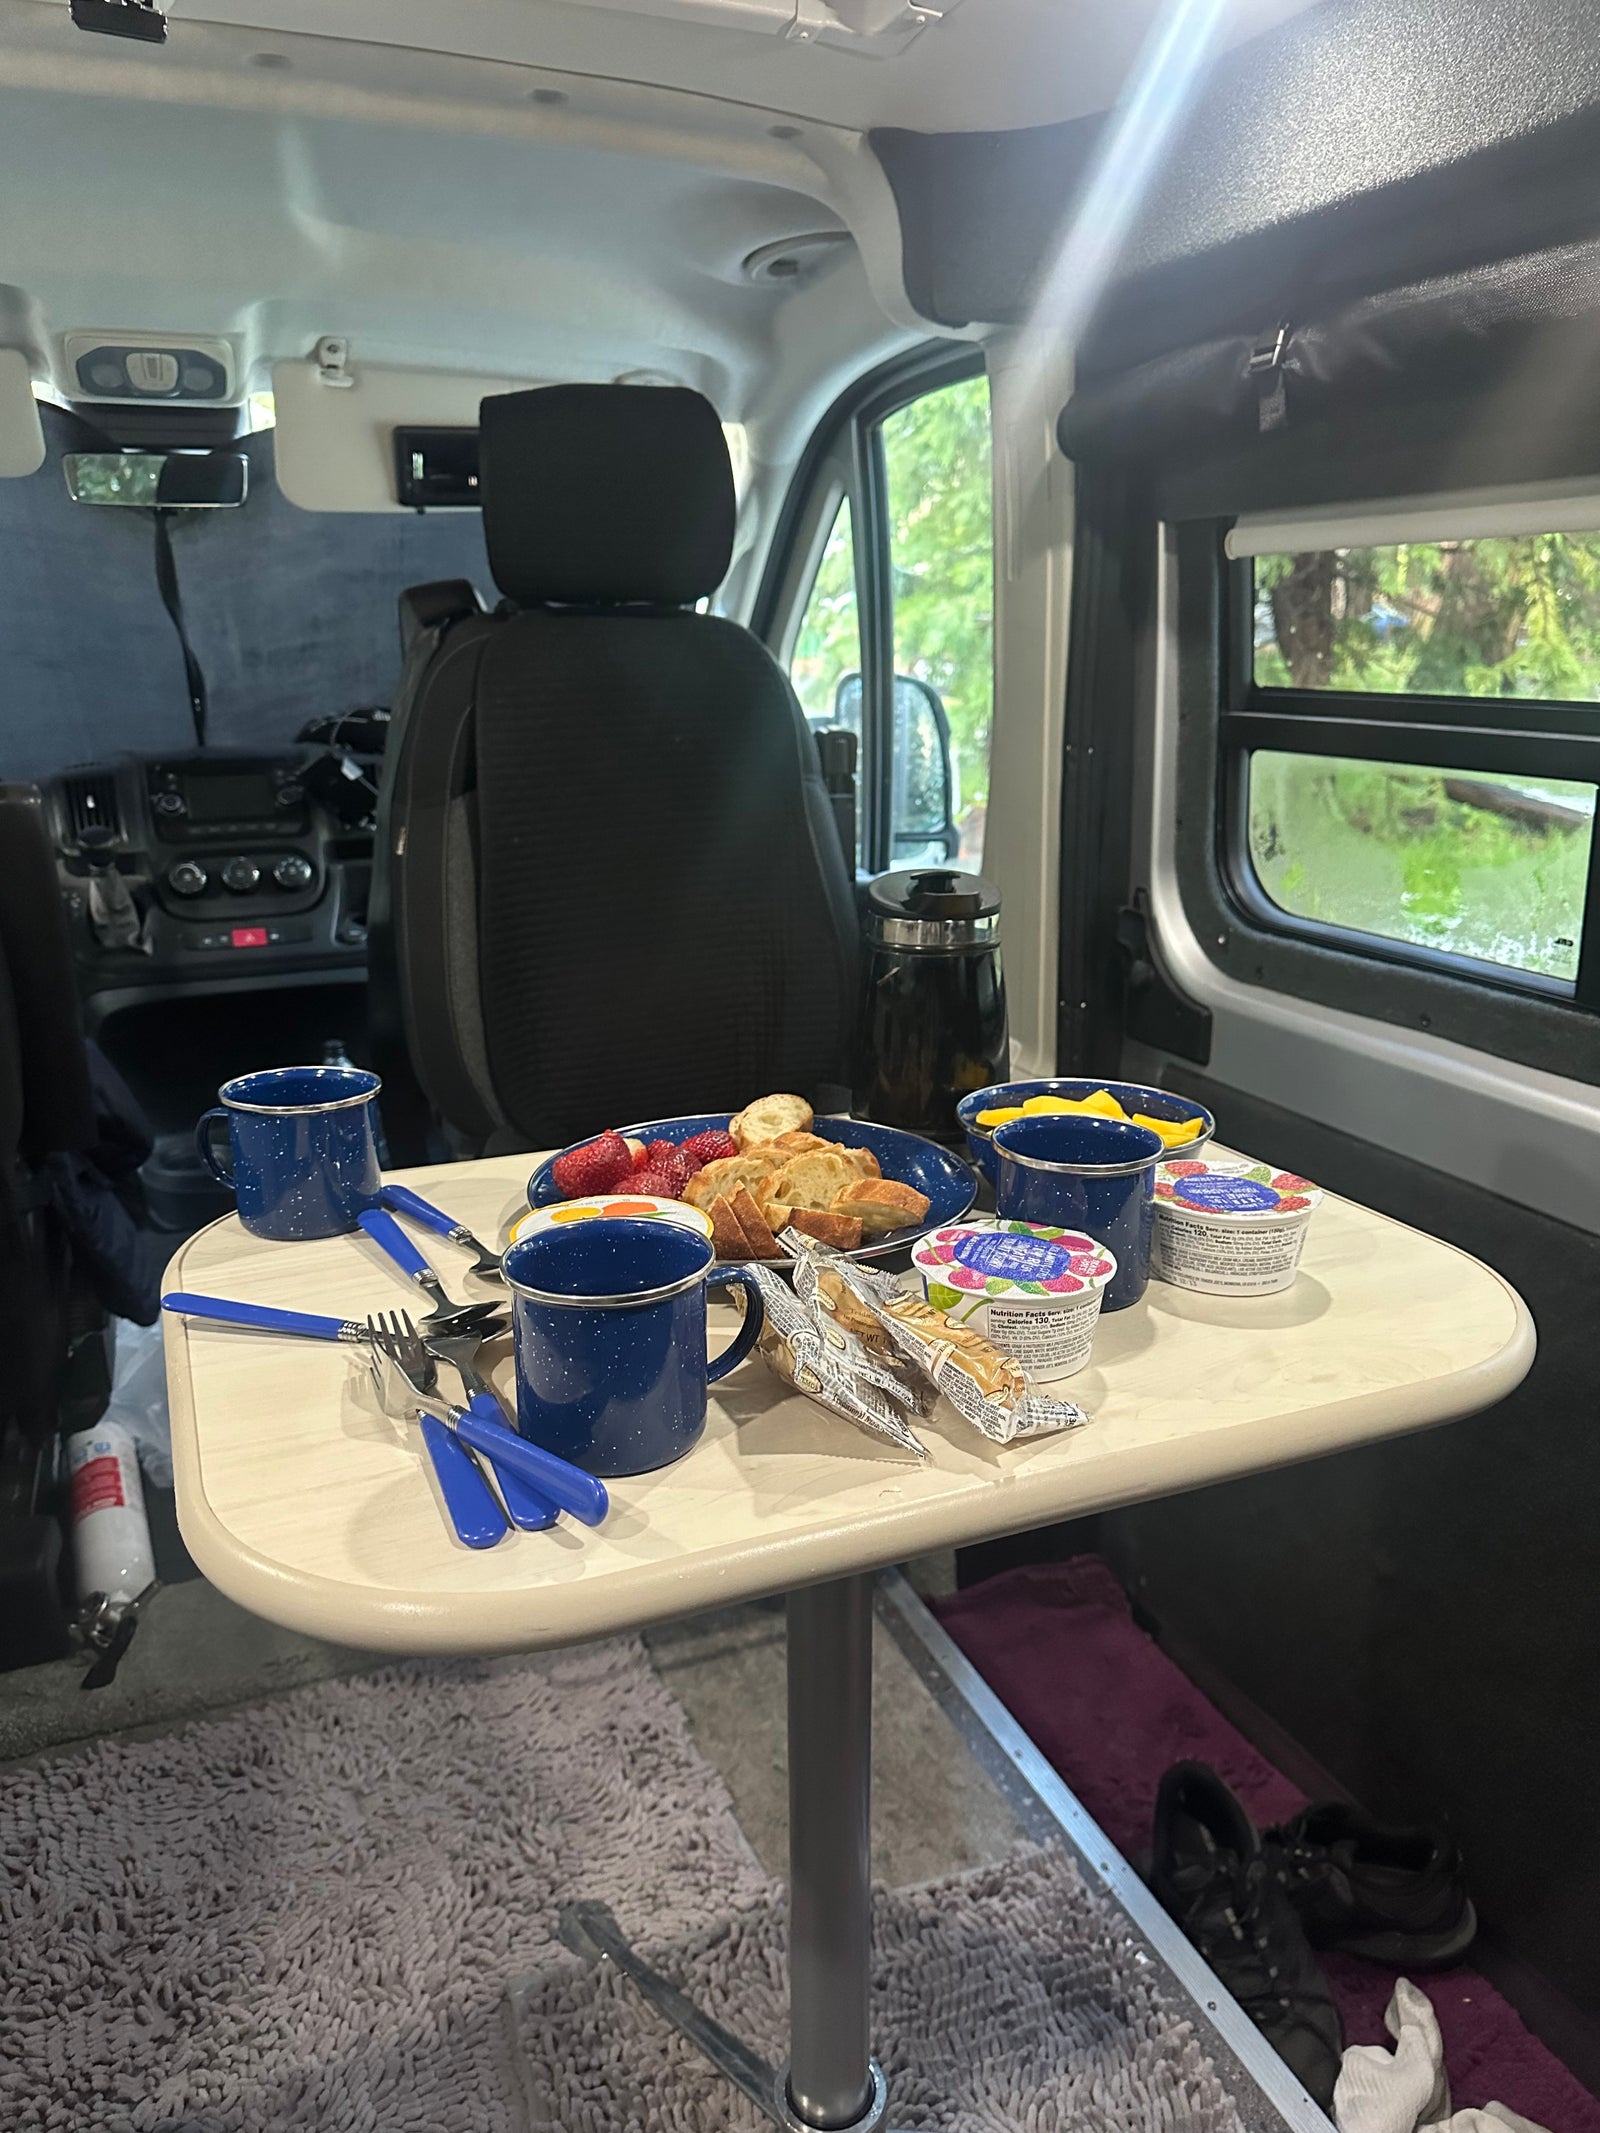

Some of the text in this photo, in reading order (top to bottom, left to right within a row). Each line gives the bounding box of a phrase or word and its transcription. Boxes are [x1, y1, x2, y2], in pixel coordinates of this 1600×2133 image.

[1159, 1214, 1184, 1226] Nutrition
[1185, 1222, 1204, 1230] Facts
[990, 1309, 1024, 1318] Nutrition
[866, 1334, 879, 1342] WT
